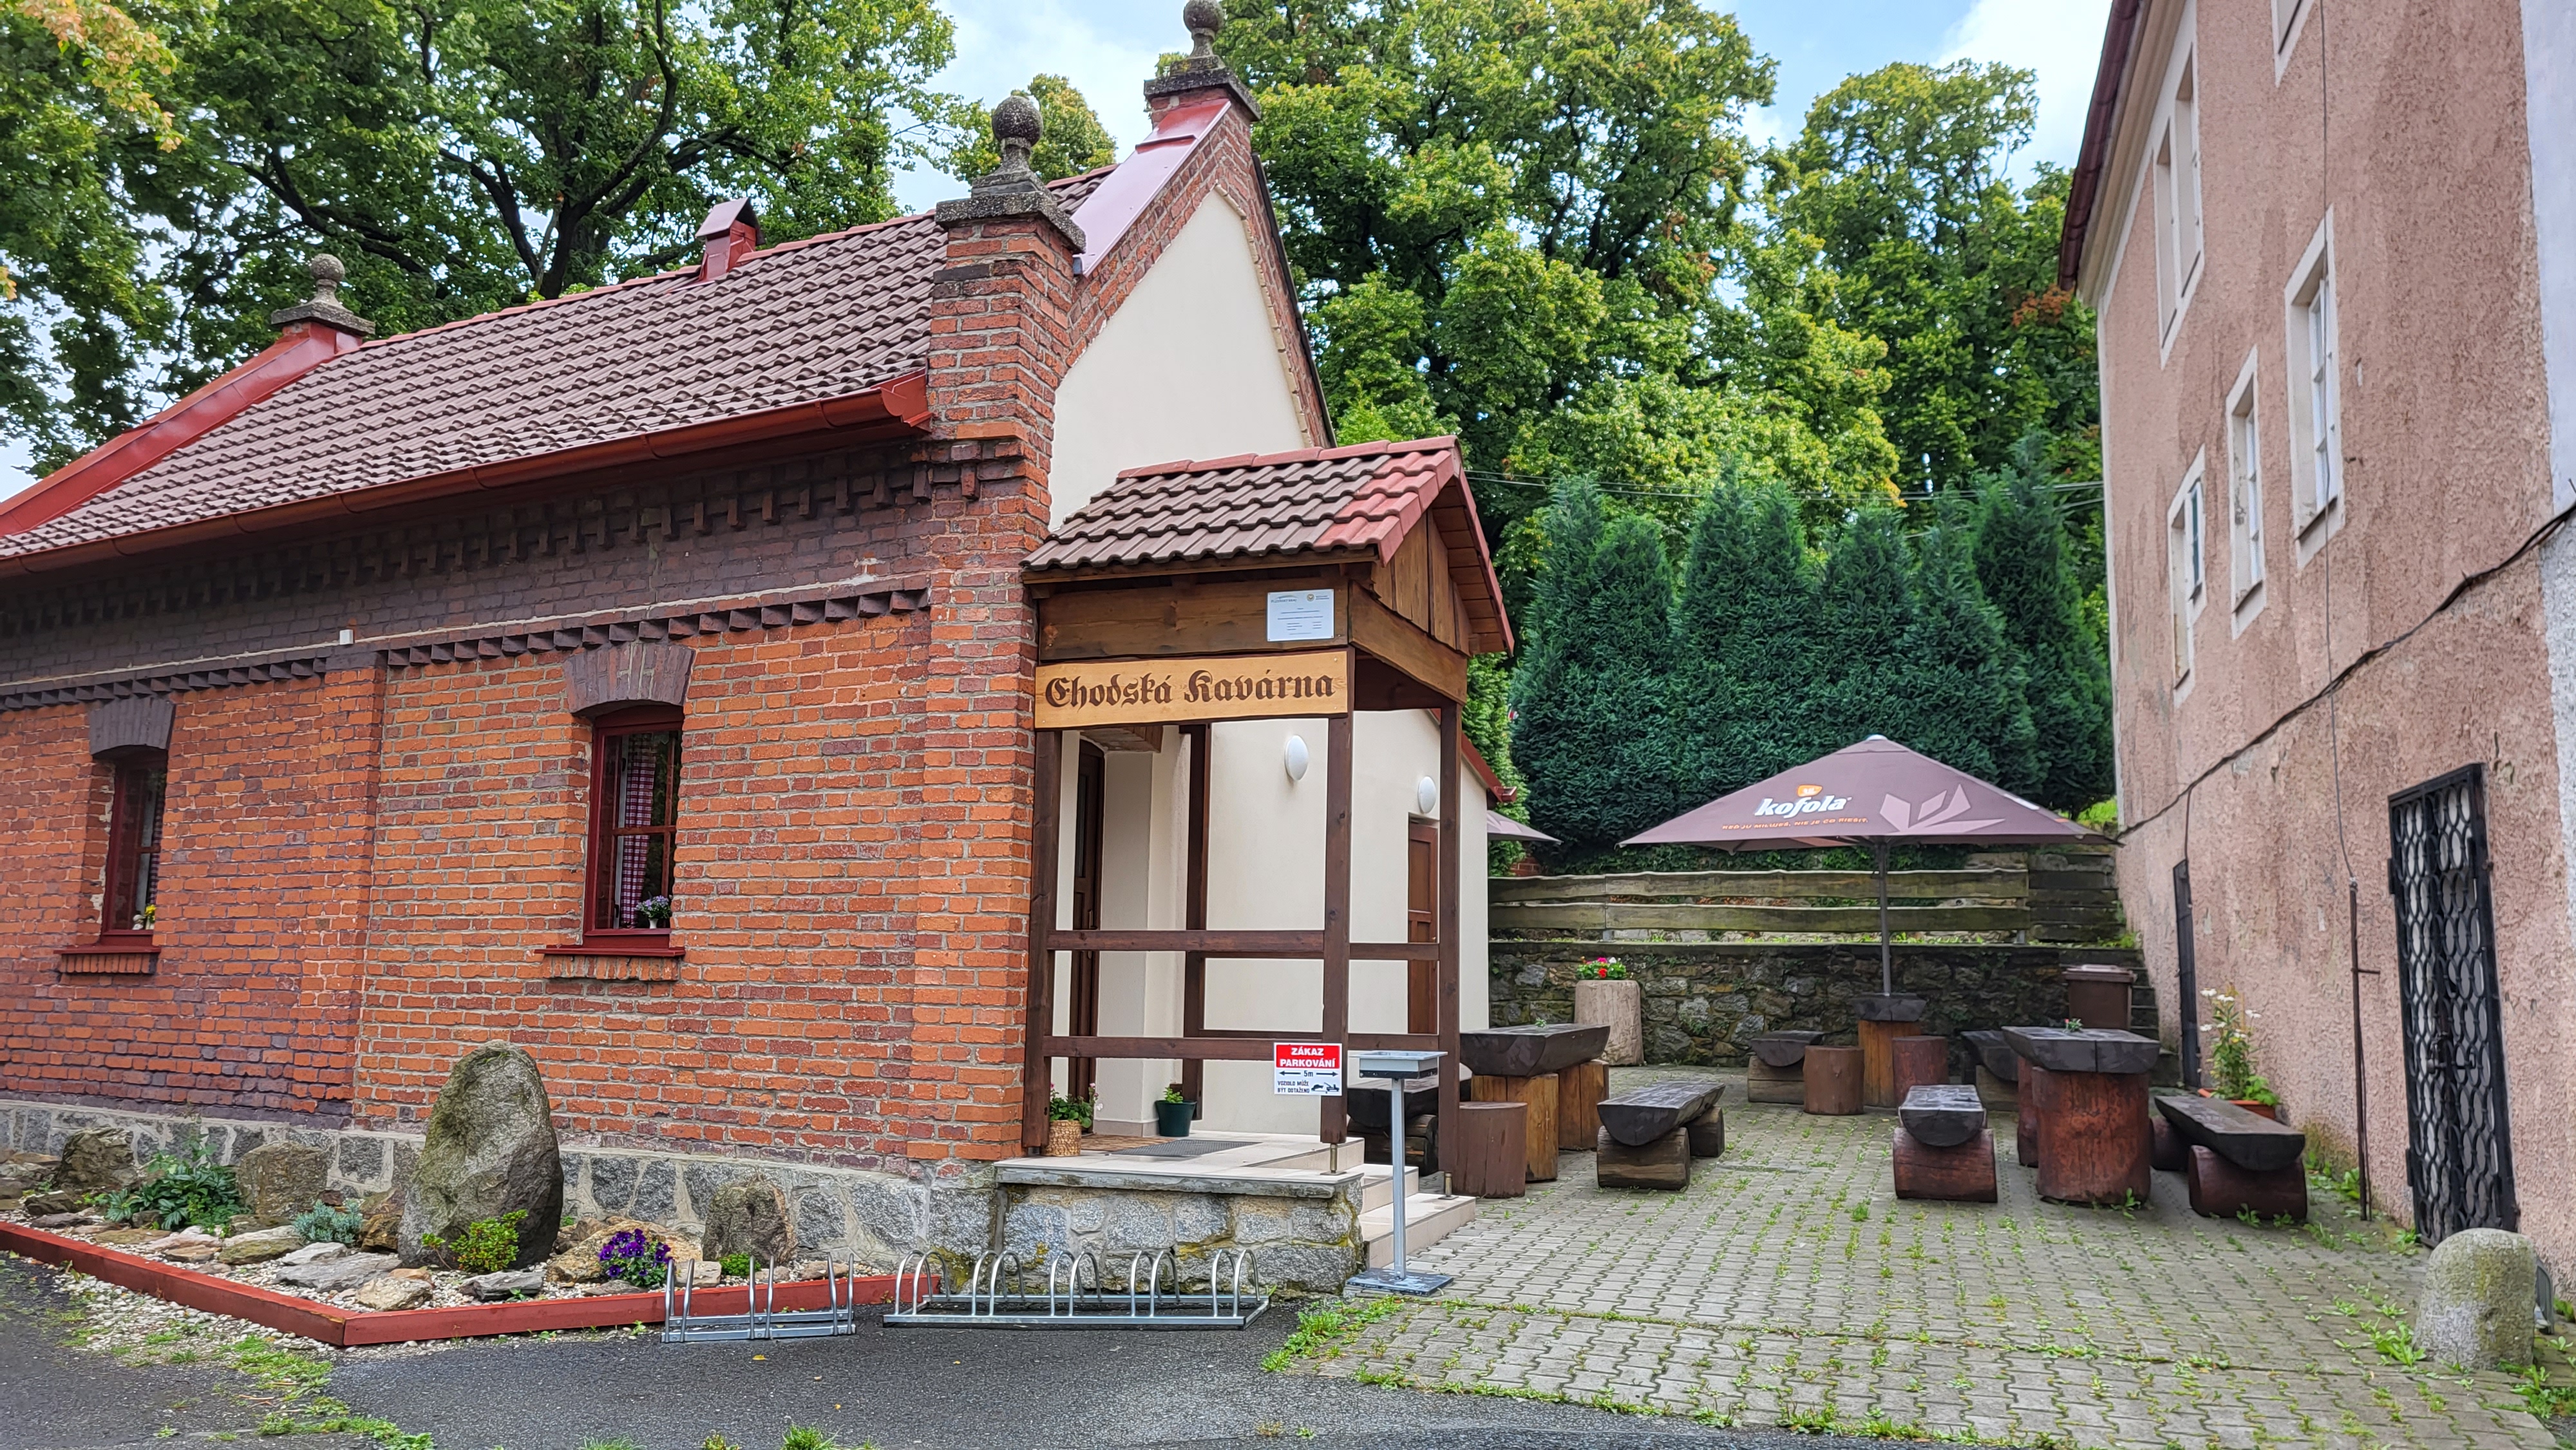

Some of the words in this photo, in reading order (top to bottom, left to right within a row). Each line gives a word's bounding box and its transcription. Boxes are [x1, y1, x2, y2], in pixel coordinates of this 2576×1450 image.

[1045, 672, 1173, 713] Chodská
[1184, 669, 1336, 703] Kavárna
[1754, 795, 1848, 818] kofola
[1291, 1046, 1324, 1056] ZÁKAZ
[1280, 1058, 1336, 1068] PARKOVÁNÍ
